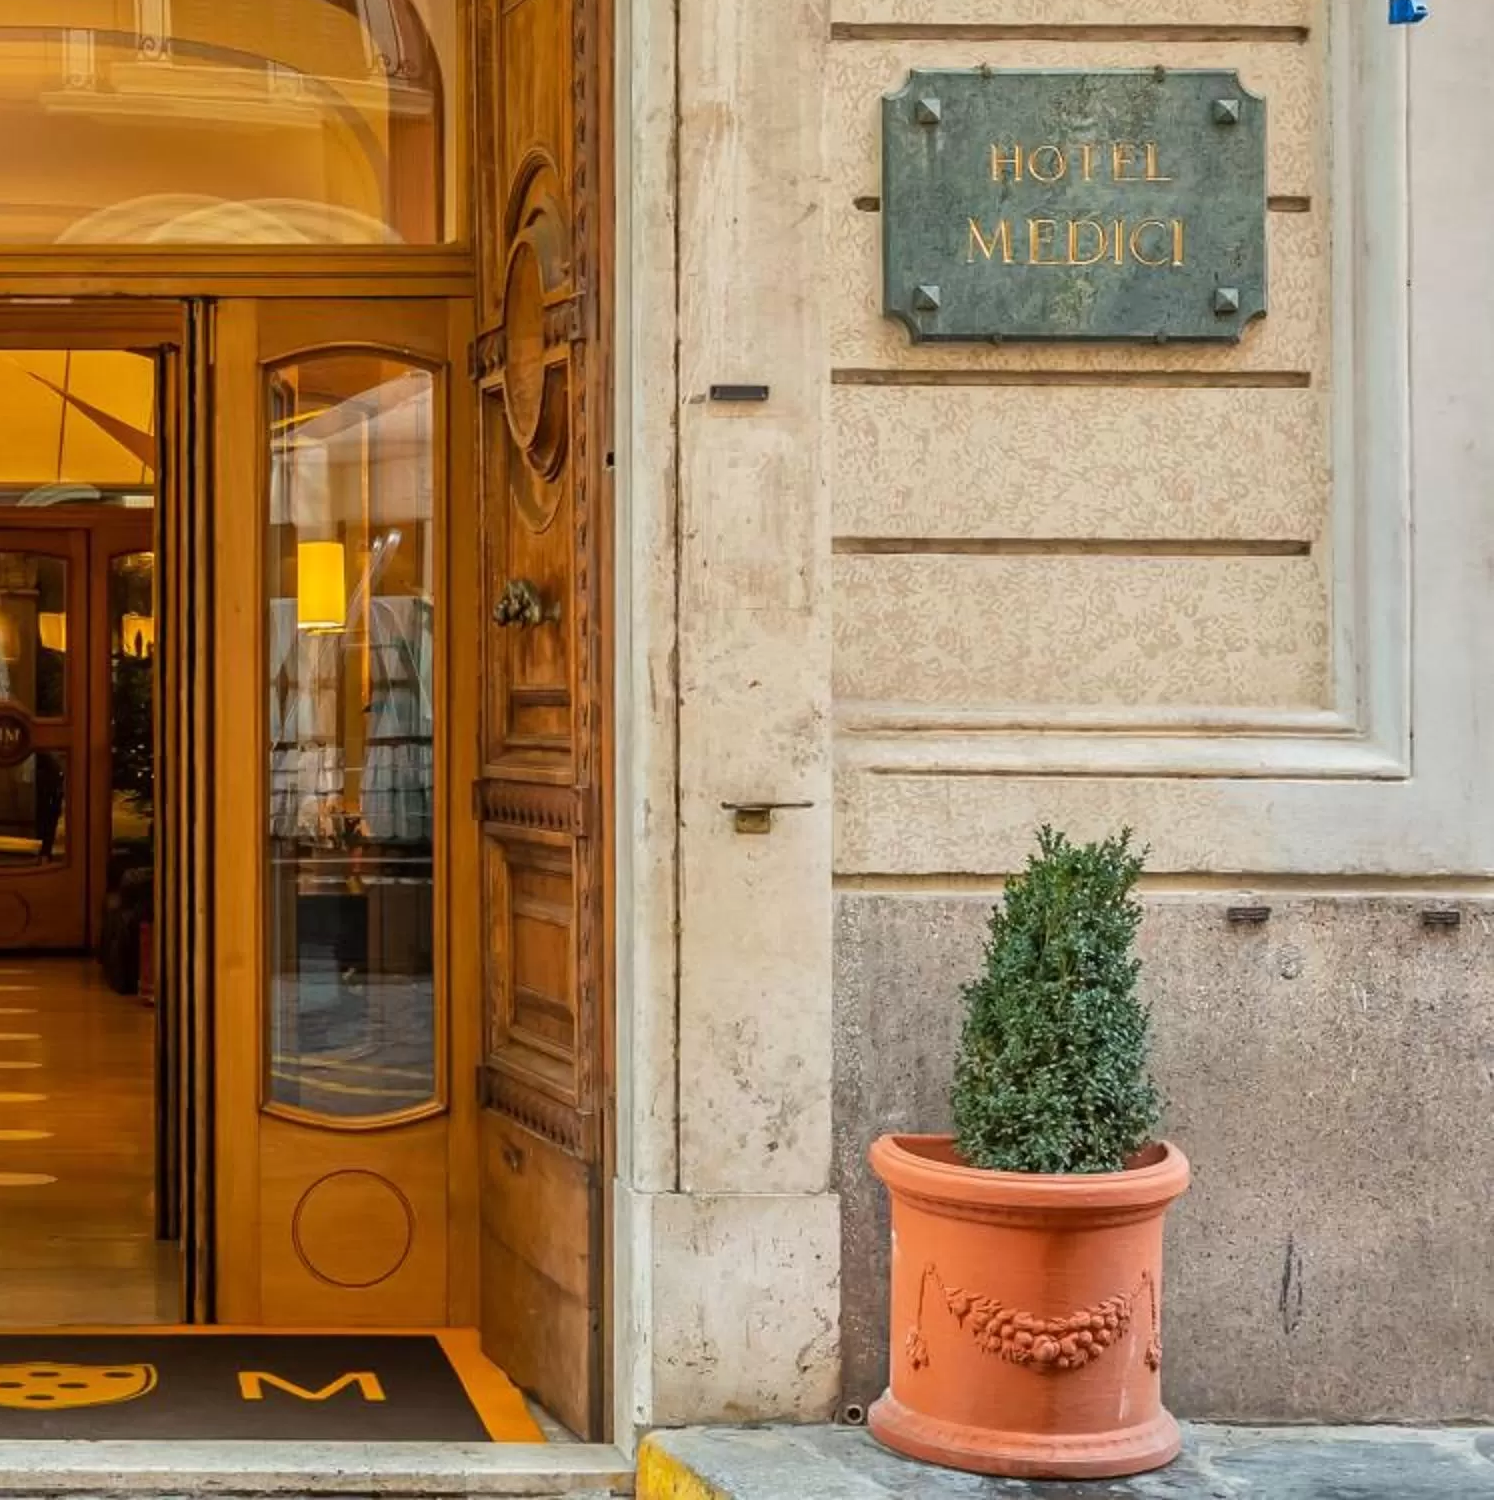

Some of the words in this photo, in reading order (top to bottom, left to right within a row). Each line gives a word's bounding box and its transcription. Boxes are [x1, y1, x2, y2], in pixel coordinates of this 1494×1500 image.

[989, 140, 1173, 183] HOTEL
[965, 217, 1187, 268] MEDICI
[237, 1371, 386, 1401] M
